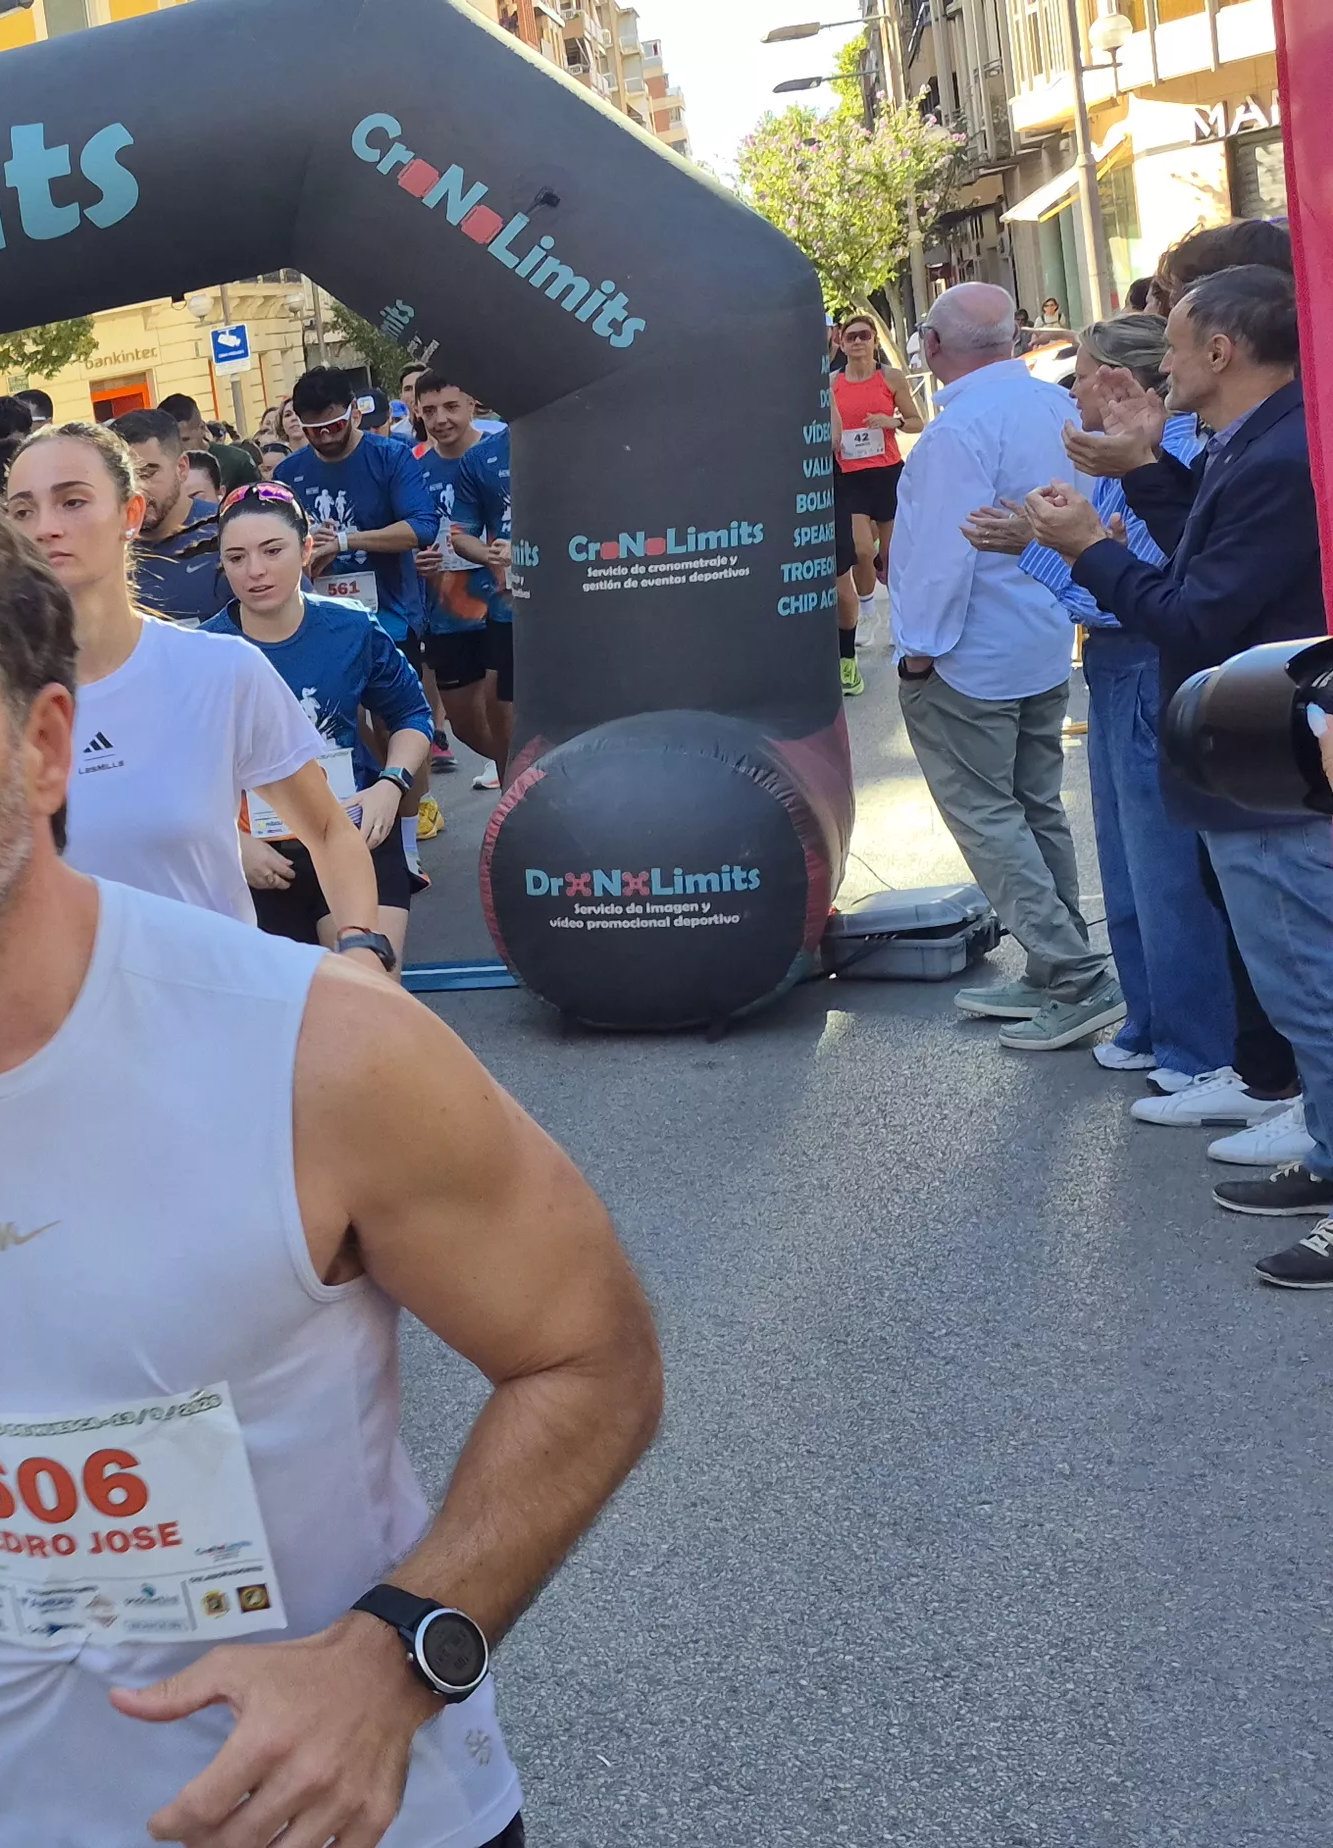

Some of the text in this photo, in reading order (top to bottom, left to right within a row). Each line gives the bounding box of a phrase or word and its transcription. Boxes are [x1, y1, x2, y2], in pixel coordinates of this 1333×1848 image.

[854, 433, 869, 442] 42
[587, 554, 738, 577] Servicio de cronometraje y
[327, 580, 360, 596] 561
[582, 567, 750, 592] gestión de eventos deportivos
[777, 592, 818, 617] CHIP
[574, 902, 623, 915] Servicio
[626, 902, 642, 914] de
[701, 901, 711, 914] y
[549, 914, 740, 930] vídeo promocional deportivo
[87, 1520, 183, 1557] JOSE
